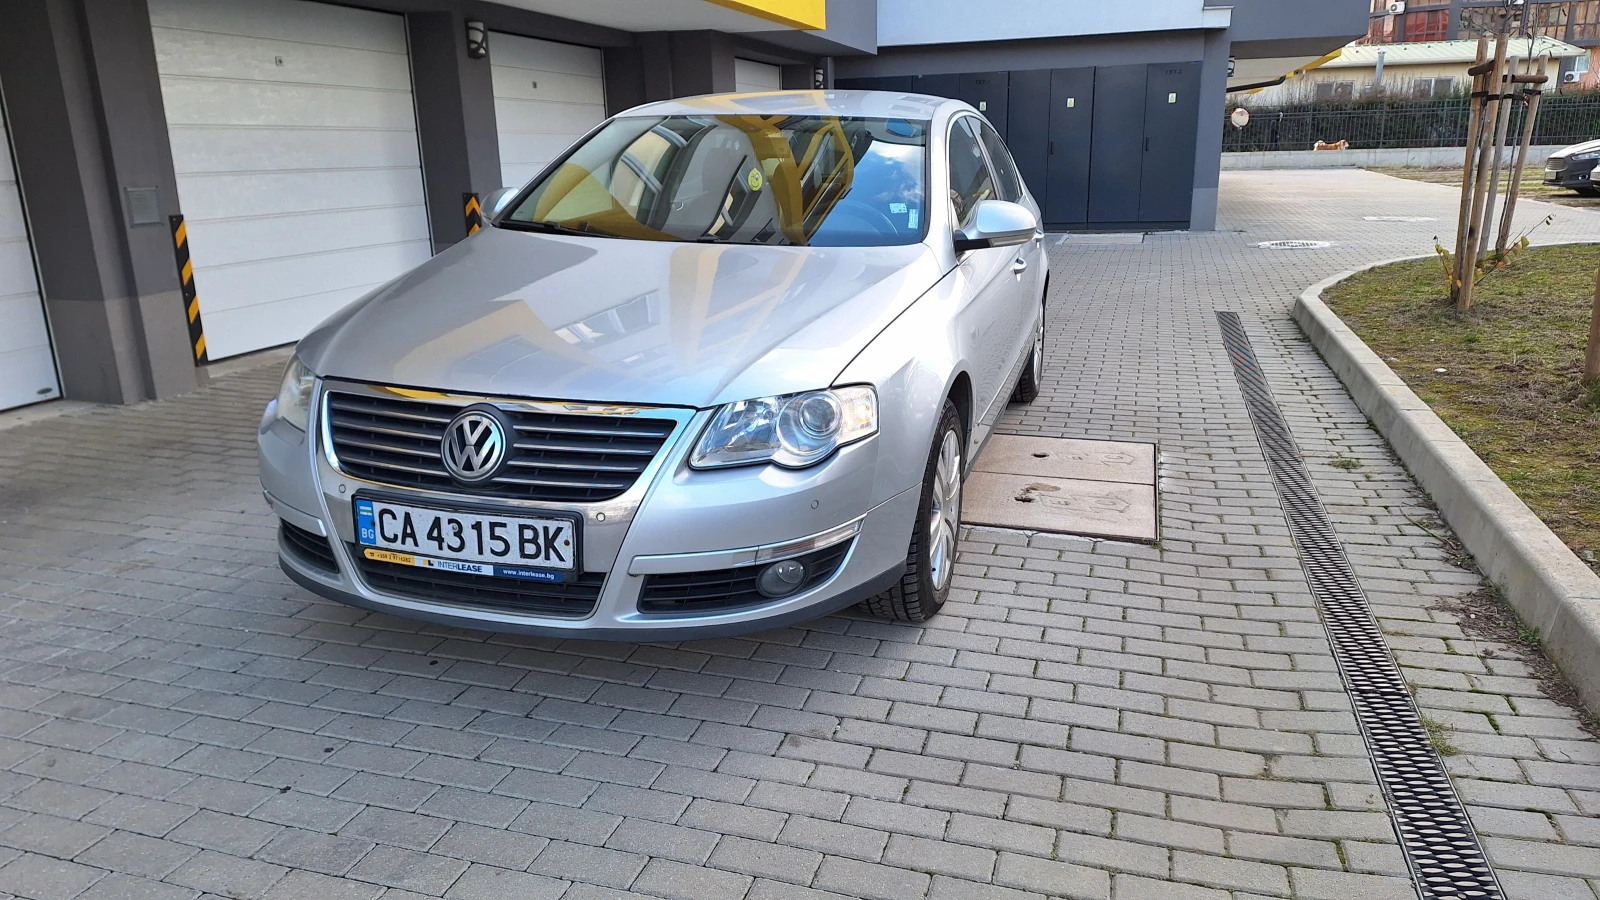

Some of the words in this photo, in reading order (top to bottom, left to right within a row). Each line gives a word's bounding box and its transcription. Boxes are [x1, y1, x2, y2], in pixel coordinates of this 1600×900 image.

[361, 527, 374, 539] BG
[378, 508, 419, 548] CA
[426, 516, 511, 557] 4315
[519, 523, 567, 563] BK
[437, 561, 483, 573] INTERLEASE
[502, 568, 555, 580] www.interlease.bg
